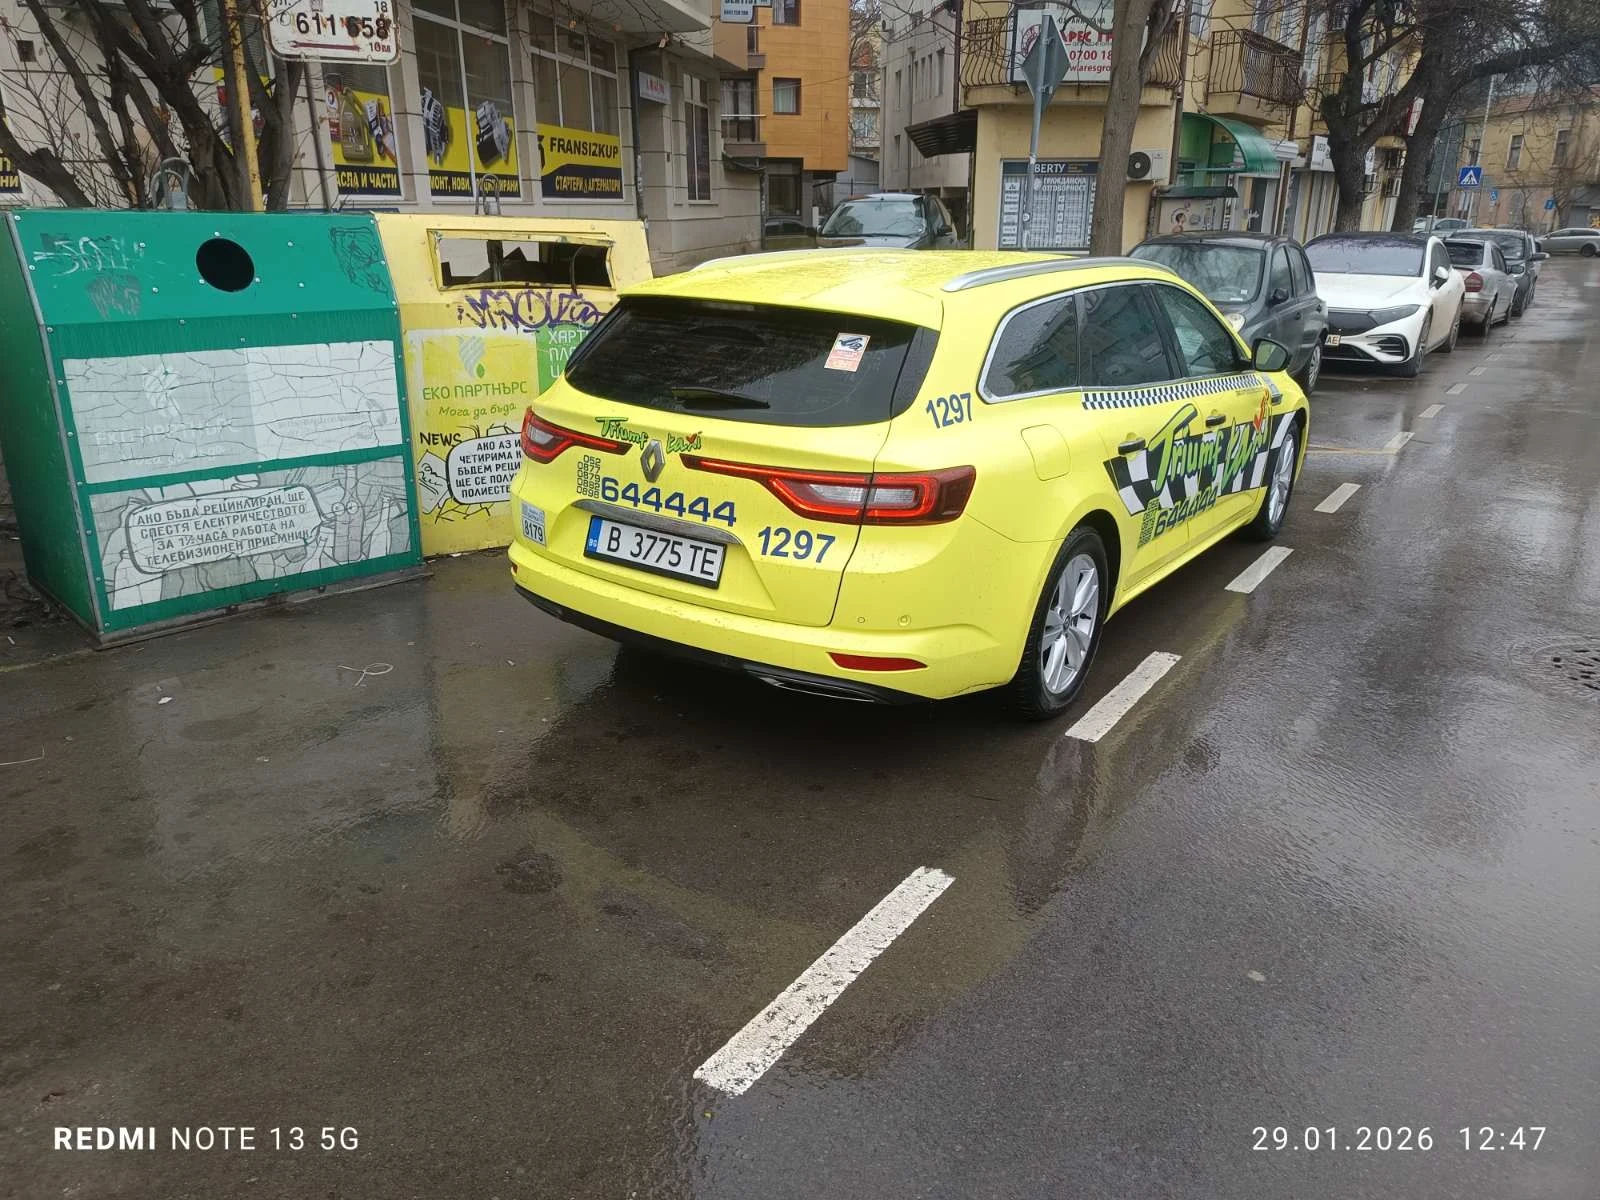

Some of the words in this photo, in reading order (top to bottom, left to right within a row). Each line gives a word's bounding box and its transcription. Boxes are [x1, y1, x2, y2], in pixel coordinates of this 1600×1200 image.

[374, 0, 389, 13] 18
[295, 12, 337, 36] 611
[1069, 50, 1098, 61] 0700
[1066, 64, 1112, 75] w.aresgro
[1034, 163, 1067, 174] BERTY
[335, 171, 360, 190] АСЛА
[369, 173, 398, 189] ЧАСТИ
[429, 176, 452, 192] МОНТ,
[549, 329, 589, 345] ХАРТ
[422, 386, 451, 401] ЕКО
[454, 380, 528, 399] ПАРТНЪРС
[438, 406, 470, 419] Мога
[473, 407, 488, 420] да
[925, 392, 973, 429] 1297
[419, 432, 461, 446] NEWS
[595, 416, 649, 451] Triumf
[477, 441, 496, 451] АКО
[498, 440, 512, 450] АЗ
[459, 452, 513, 464] ЧЕТИРИМА
[457, 464, 493, 476] БЪДЕМ
[495, 461, 521, 472] РЕЦИ
[455, 477, 471, 488] ЩЕ
[474, 476, 487, 486] СЕ
[489, 473, 517, 484] ПОЛУ
[461, 485, 511, 498] ПОЛИЕСТЕ
[137, 514, 163, 525] АКО
[166, 507, 200, 522] БЪДА
[287, 491, 305, 502] ЩЕ
[601, 476, 737, 527] 644444
[140, 523, 191, 540] СПЕСТЯ
[194, 504, 307, 530] ЕЛЕКТРИЧЕСТВОТО
[524, 519, 544, 542] 8179
[156, 540, 175, 551] ЗА
[196, 531, 229, 545] ЧАСА
[231, 521, 278, 539] РАБОТА
[280, 519, 296, 530] НА
[607, 526, 622, 553] B
[630, 532, 684, 567] 3775
[688, 543, 718, 577] TE
[757, 525, 836, 564] 1297
[146, 541, 245, 566] ТЕЛЕВИЗИОНЕН
